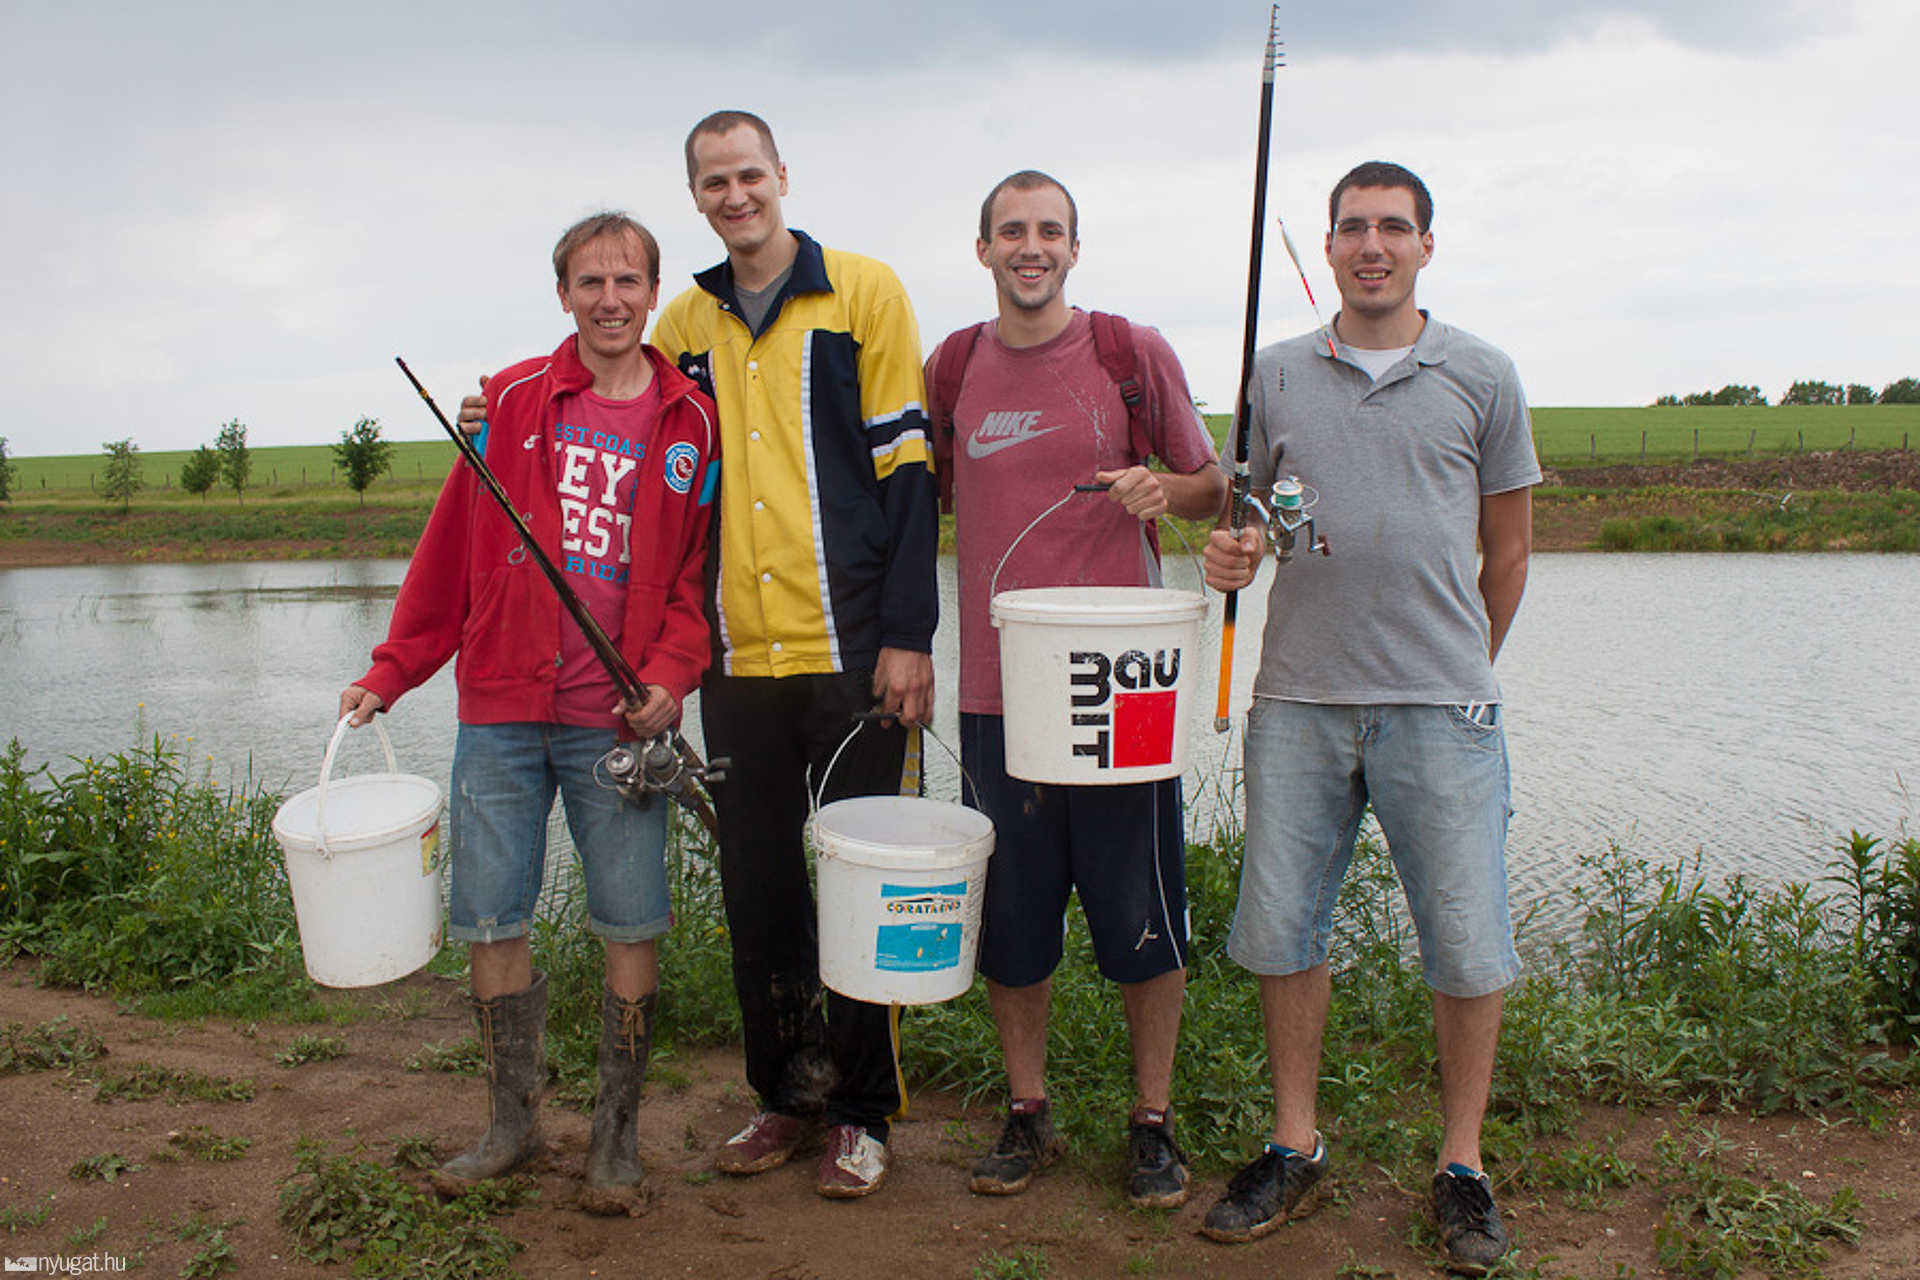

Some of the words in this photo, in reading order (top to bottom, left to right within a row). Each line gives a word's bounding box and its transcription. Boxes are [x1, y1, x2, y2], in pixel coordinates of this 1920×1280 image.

[978, 411, 1043, 436] NIKE
[592, 431, 646, 459] COAS
[555, 442, 637, 506] EY
[565, 555, 630, 584] RIDA
